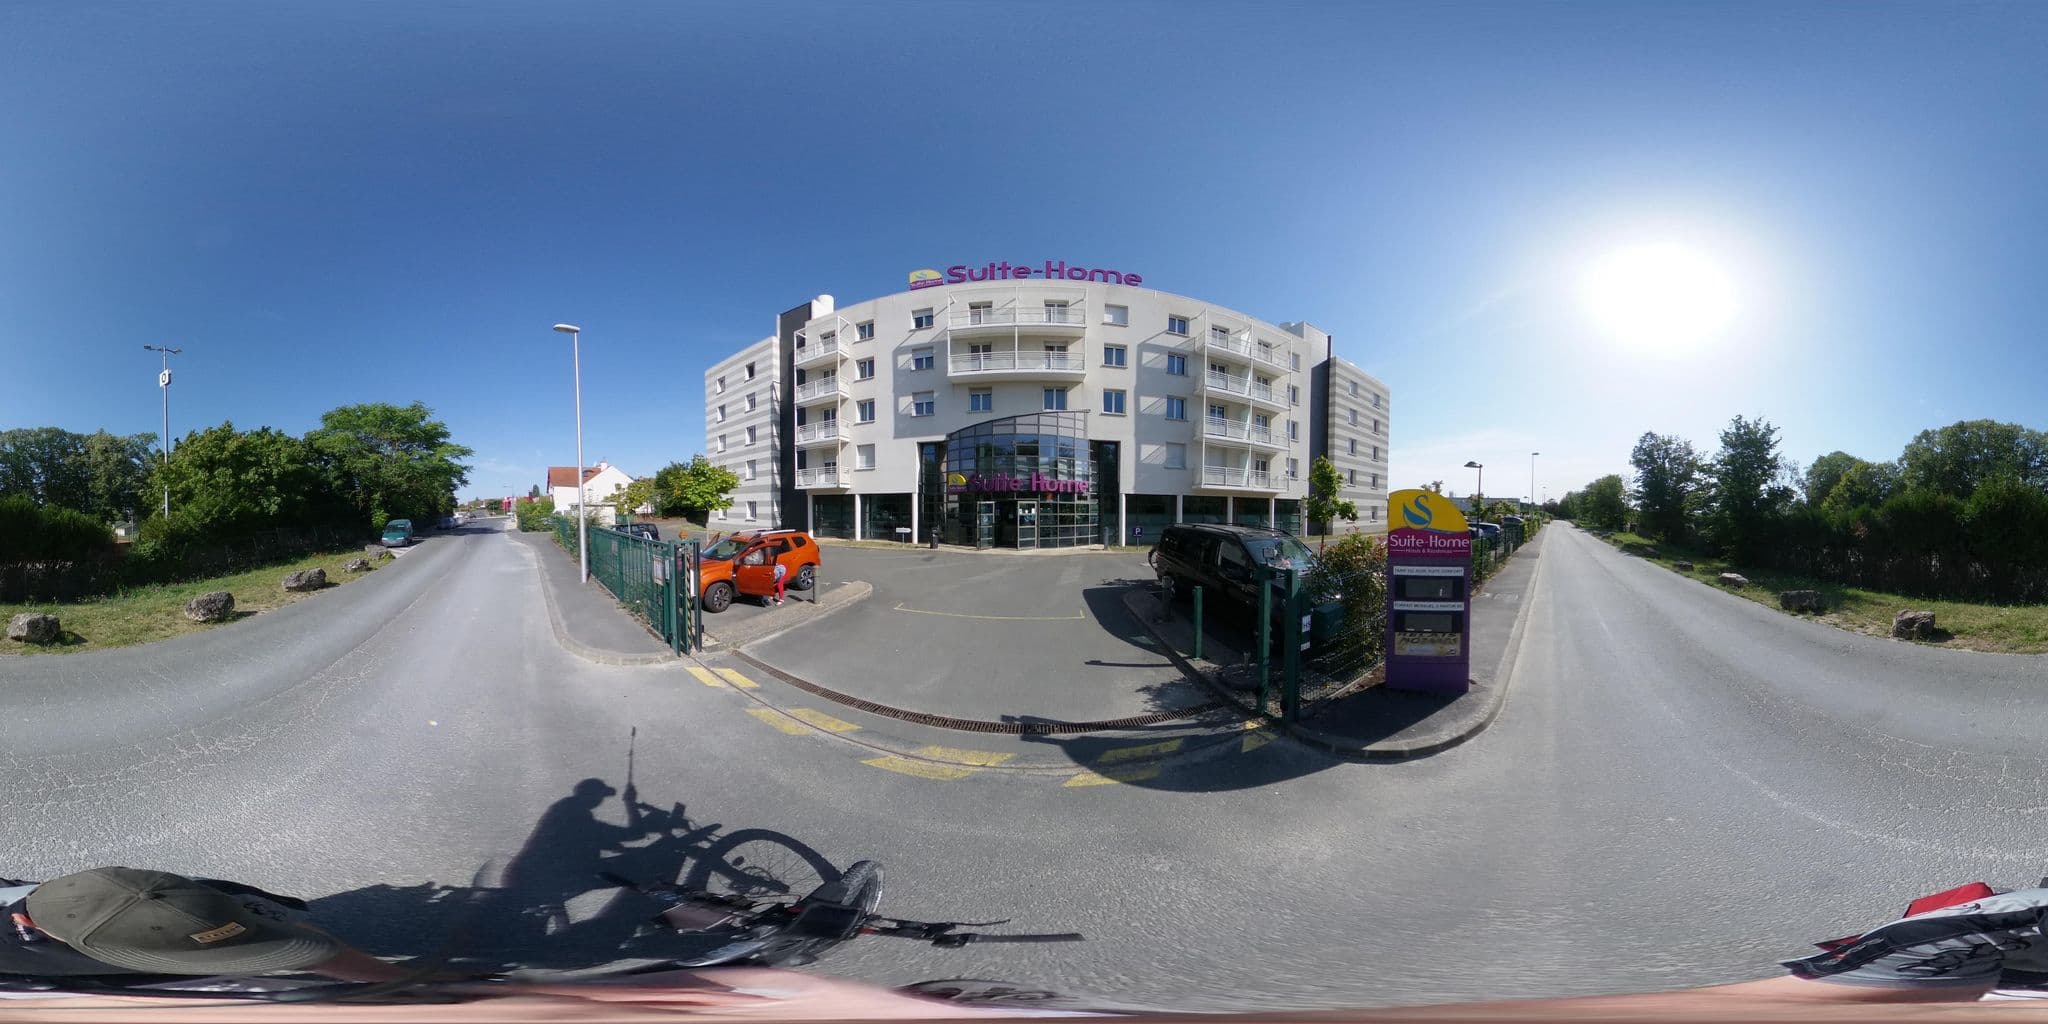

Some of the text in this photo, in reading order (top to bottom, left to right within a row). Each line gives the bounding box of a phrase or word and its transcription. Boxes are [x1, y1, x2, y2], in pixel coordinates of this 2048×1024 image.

[947, 261, 1143, 287] Suite-Home
[1135, 527, 1141, 535] P
[1390, 534, 1470, 548] Suite-Home
